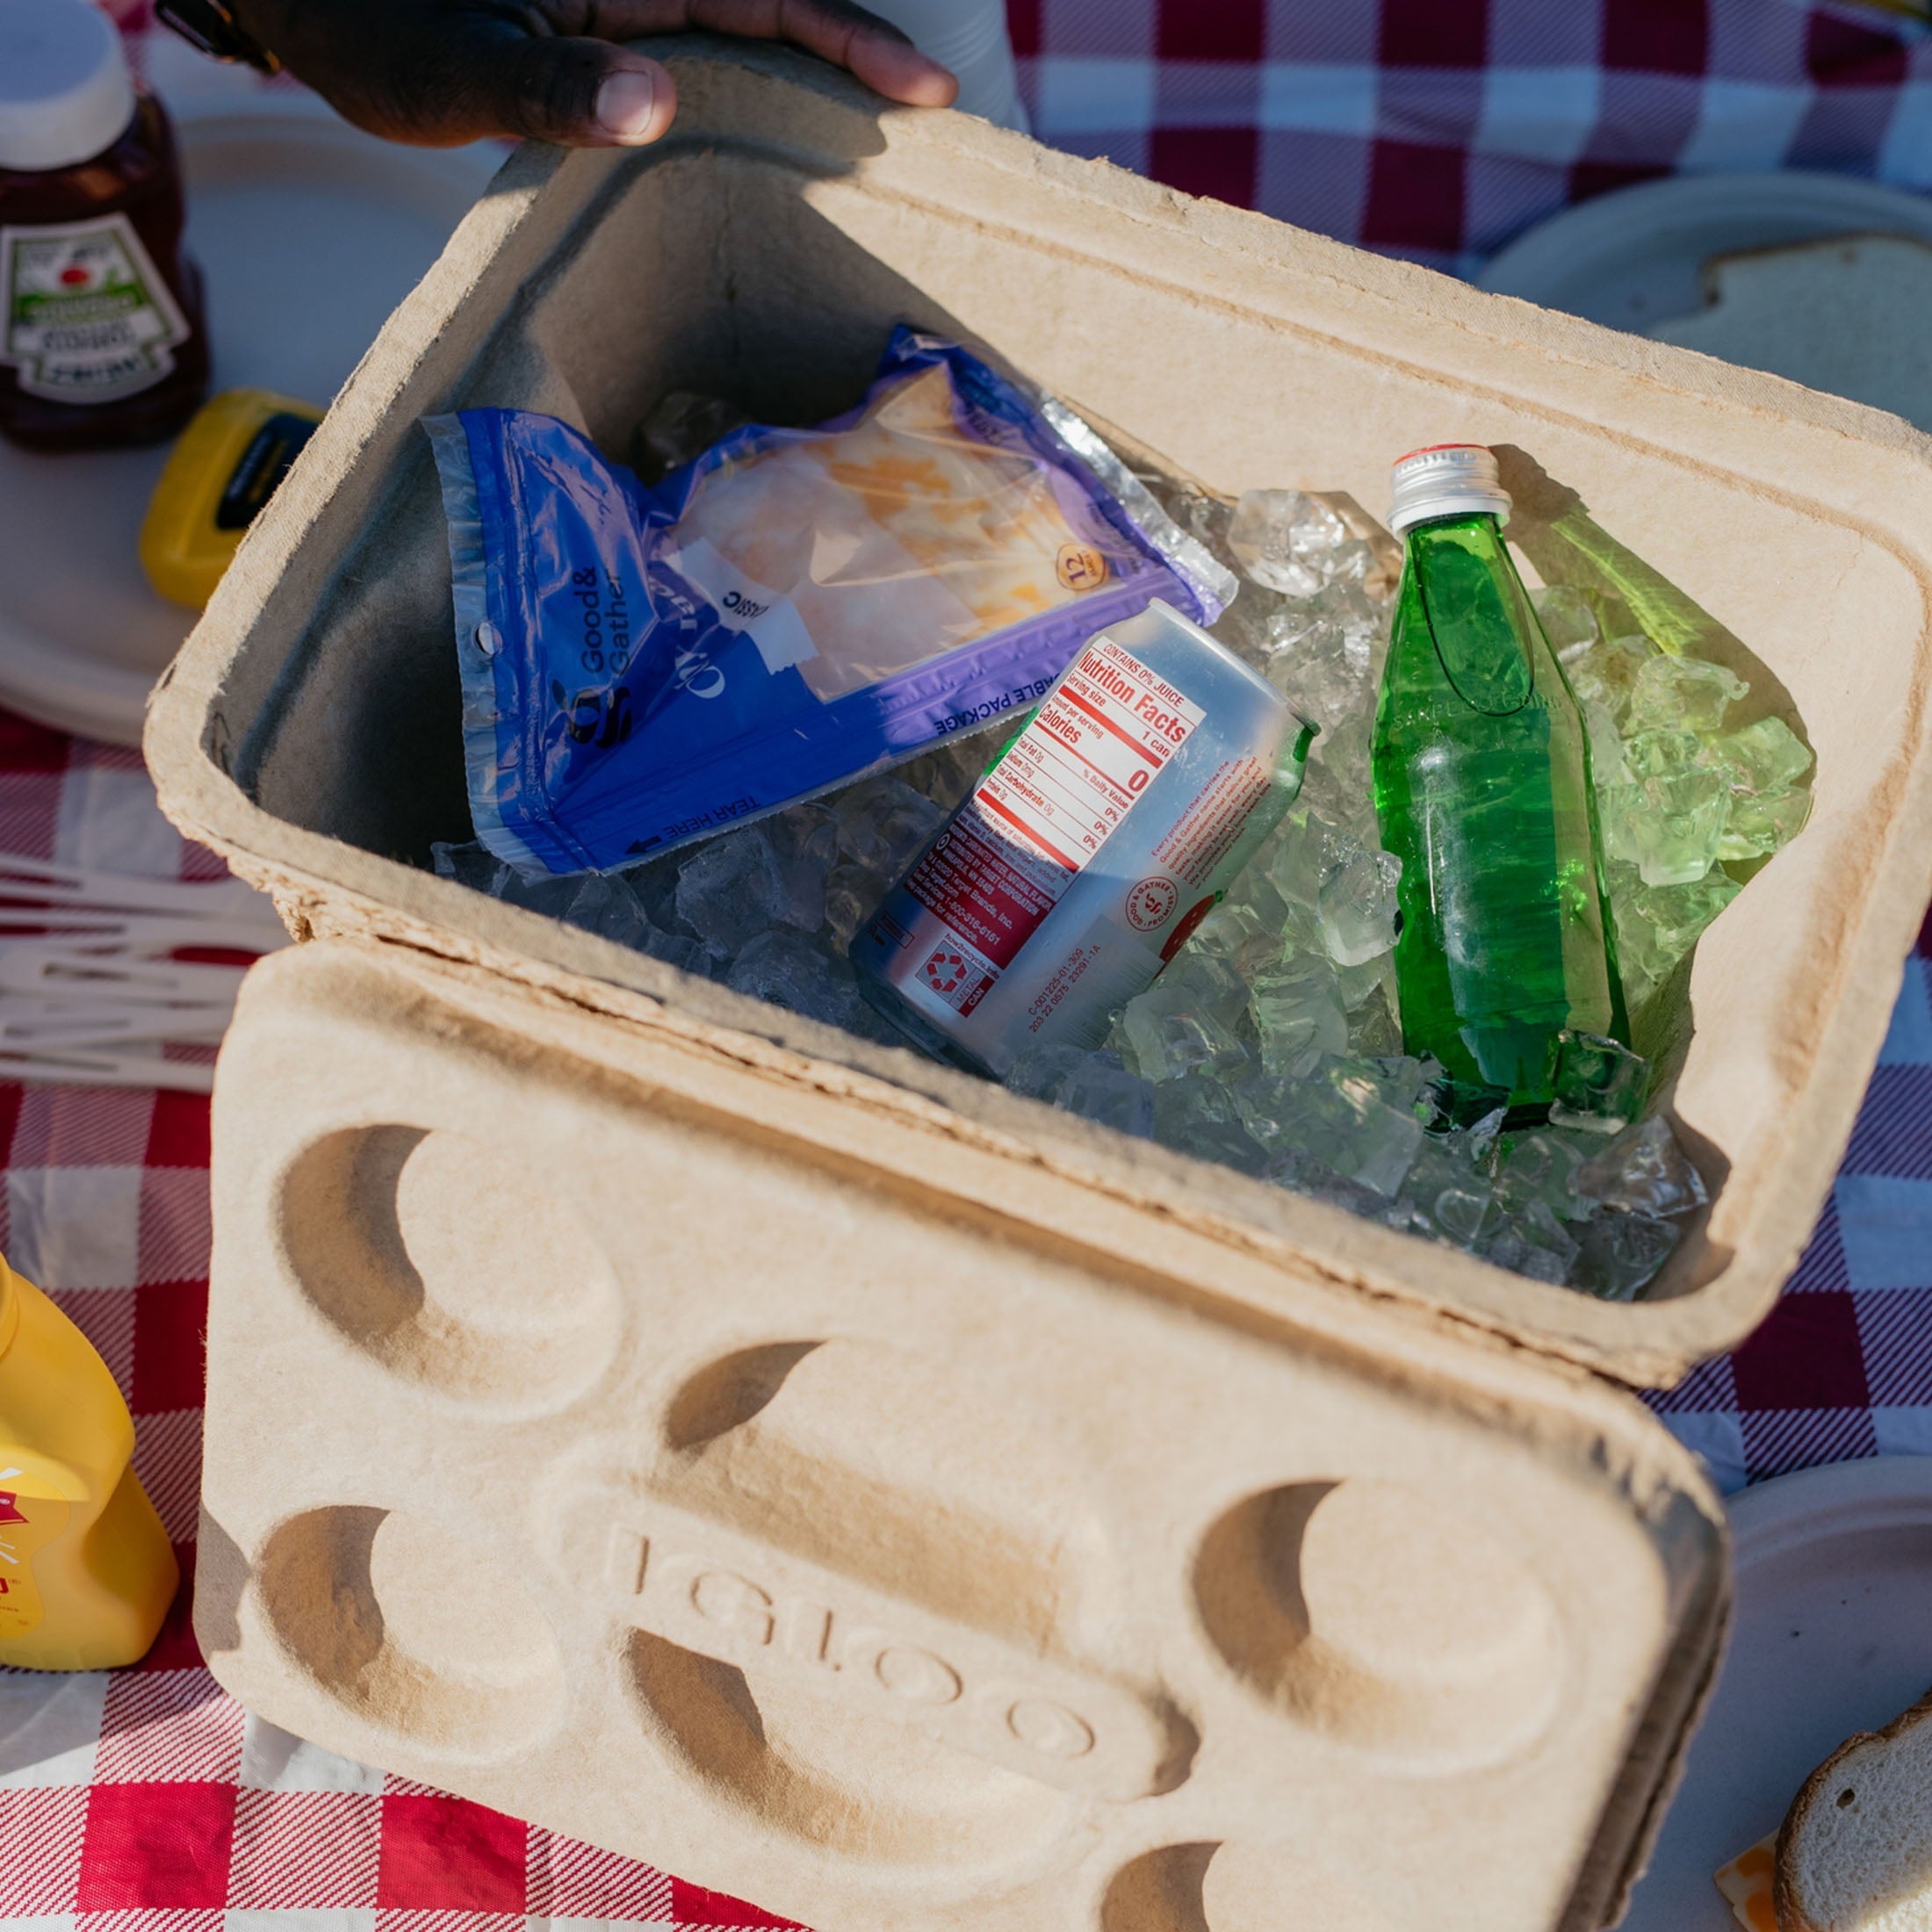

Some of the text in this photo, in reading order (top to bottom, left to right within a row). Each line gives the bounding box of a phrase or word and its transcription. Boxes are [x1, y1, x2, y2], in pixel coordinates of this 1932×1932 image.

[1062, 551, 1089, 584] 12
[605, 567, 631, 675] Gather
[1077, 649, 1190, 744] Nutrition Facts
[1103, 641, 1184, 708] CONTAINS 0% JUICE
[933, 693, 1013, 735] PACKAGE
[1064, 672, 1171, 758] Serving size 1 can
[1065, 706, 1078, 720] per
[1076, 714, 1105, 739] serving
[1038, 702, 1151, 794] Calories 0
[1003, 770, 1046, 808] Carbohydrate
[1081, 833, 1099, 849] 0%
[1025, 743, 1038, 757] Fat
[1103, 805, 1121, 822] 0%
[1081, 768, 1129, 810] % Daily Value
[1150, 760, 1229, 857] Every product that carries the
[661, 793, 761, 840] TEAR HERE
[1092, 819, 1110, 836] 0%
[1158, 842, 1177, 863] Good
[1179, 812, 1200, 837] Gather
[1199, 794, 1215, 813] name
[1215, 775, 1231, 793] starts
[1229, 759, 1244, 774] with
[1167, 847, 1187, 869] quality
[1185, 811, 1215, 847] ingredients
[1214, 797, 1226, 811] that
[1242, 757, 1258, 775] great
[1190, 830, 1213, 856] making
[1215, 804, 1232, 825] easier
[1230, 793, 1240, 804] for
[1250, 766, 1262, 780] and
[1193, 843, 1212, 864] family
[926, 868, 962, 898] Target.com
[949, 873, 972, 894] Target
[968, 889, 1000, 918] Brands,
[997, 912, 1016, 929] Inc.
[977, 864, 1000, 884] TARGET
[997, 879, 1040, 916] CORPORATION
[1130, 902, 1143, 924] GOOD
[1137, 880, 1170, 893] GATHER
[1147, 894, 1173, 926] PROMISE
[934, 902, 947, 914] for
[942, 911, 981, 943] reference.
[943, 933, 1001, 980] how2recycle.info
[1027, 946, 1085, 1016] C-001225-01-309
[955, 975, 980, 1003] METAL
[967, 987, 984, 1006] CAN
[1028, 942, 1100, 1033] 203 22 0575 23291-1A
[606, 1521, 1098, 1762] IGLOO
